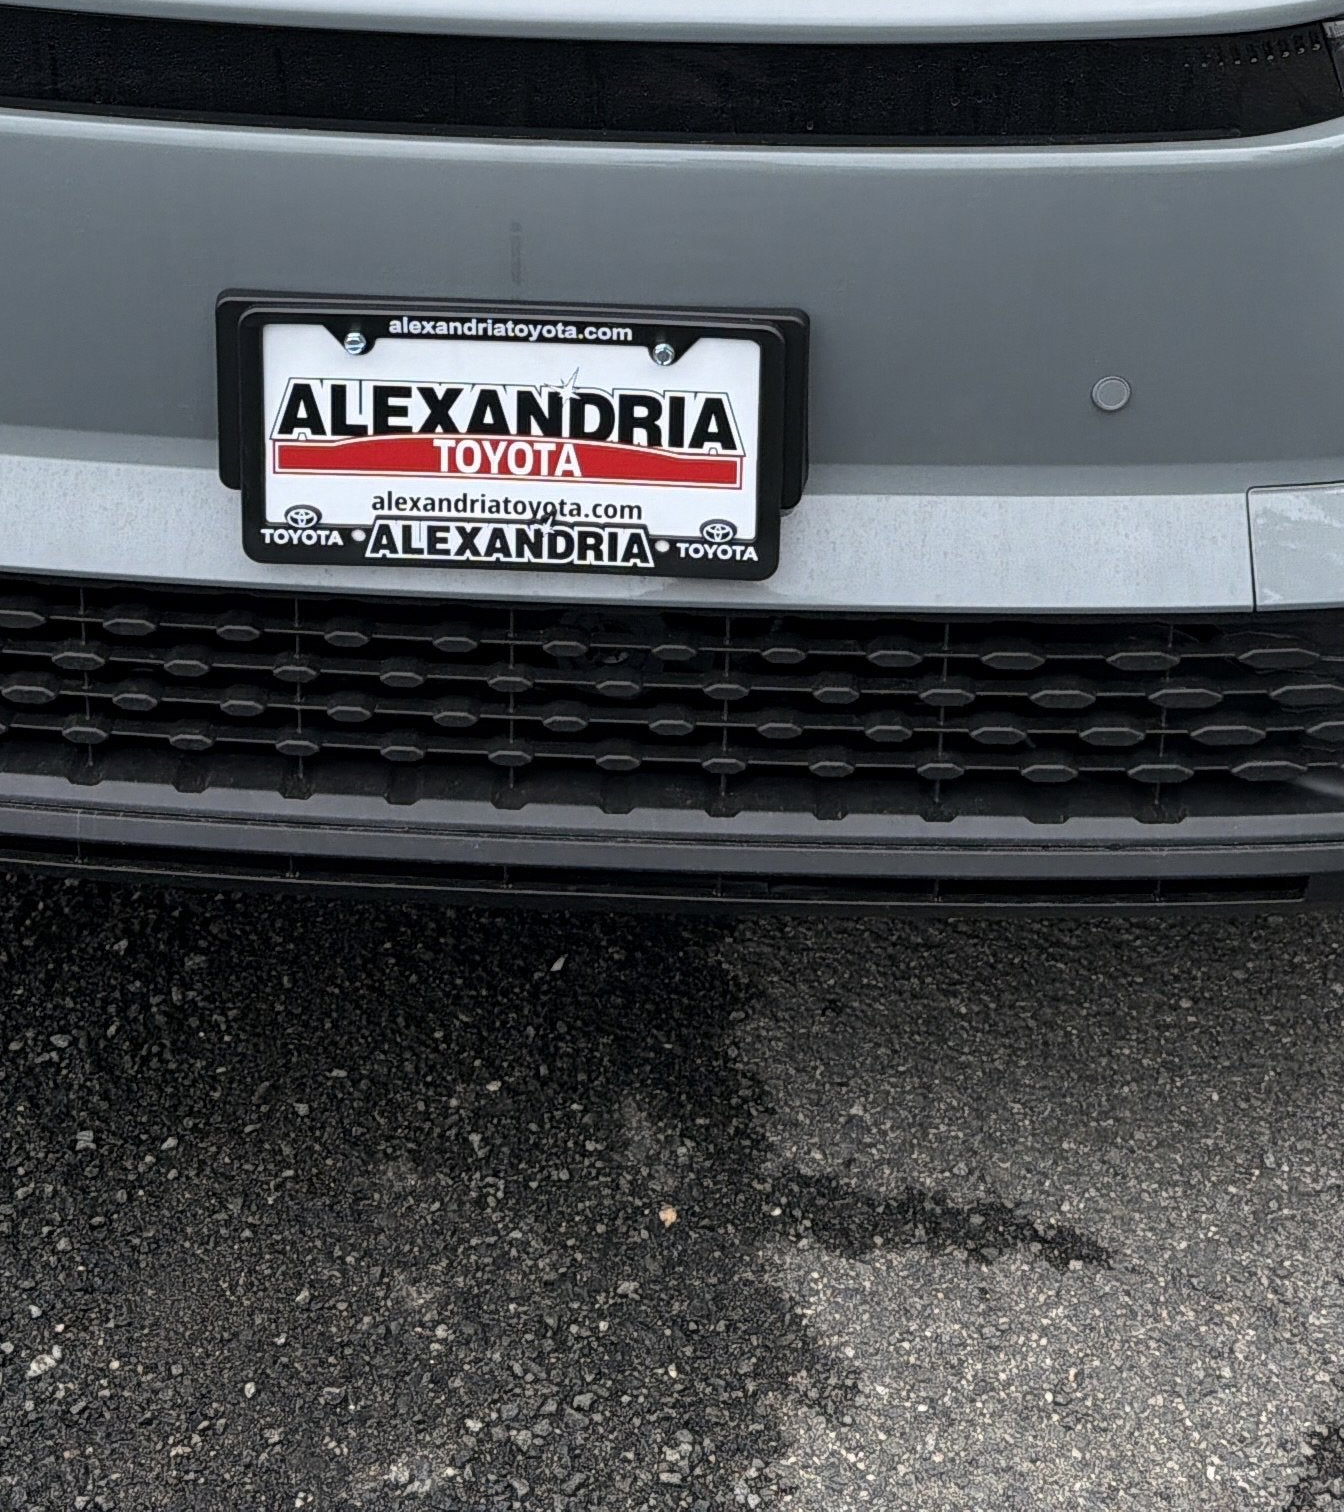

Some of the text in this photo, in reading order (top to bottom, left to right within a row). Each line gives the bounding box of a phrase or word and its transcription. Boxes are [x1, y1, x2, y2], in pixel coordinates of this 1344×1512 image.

[388, 317, 633, 342] alexandriatoyota.com
[274, 379, 742, 454] ALEXANDRIA
[433, 438, 583, 478] TOYOTA
[371, 491, 643, 522] alexandriatoyota.com
[260, 528, 344, 547] TOYOTA
[366, 520, 654, 567] ALEXANDRIA
[675, 542, 759, 562] TOYOTA
